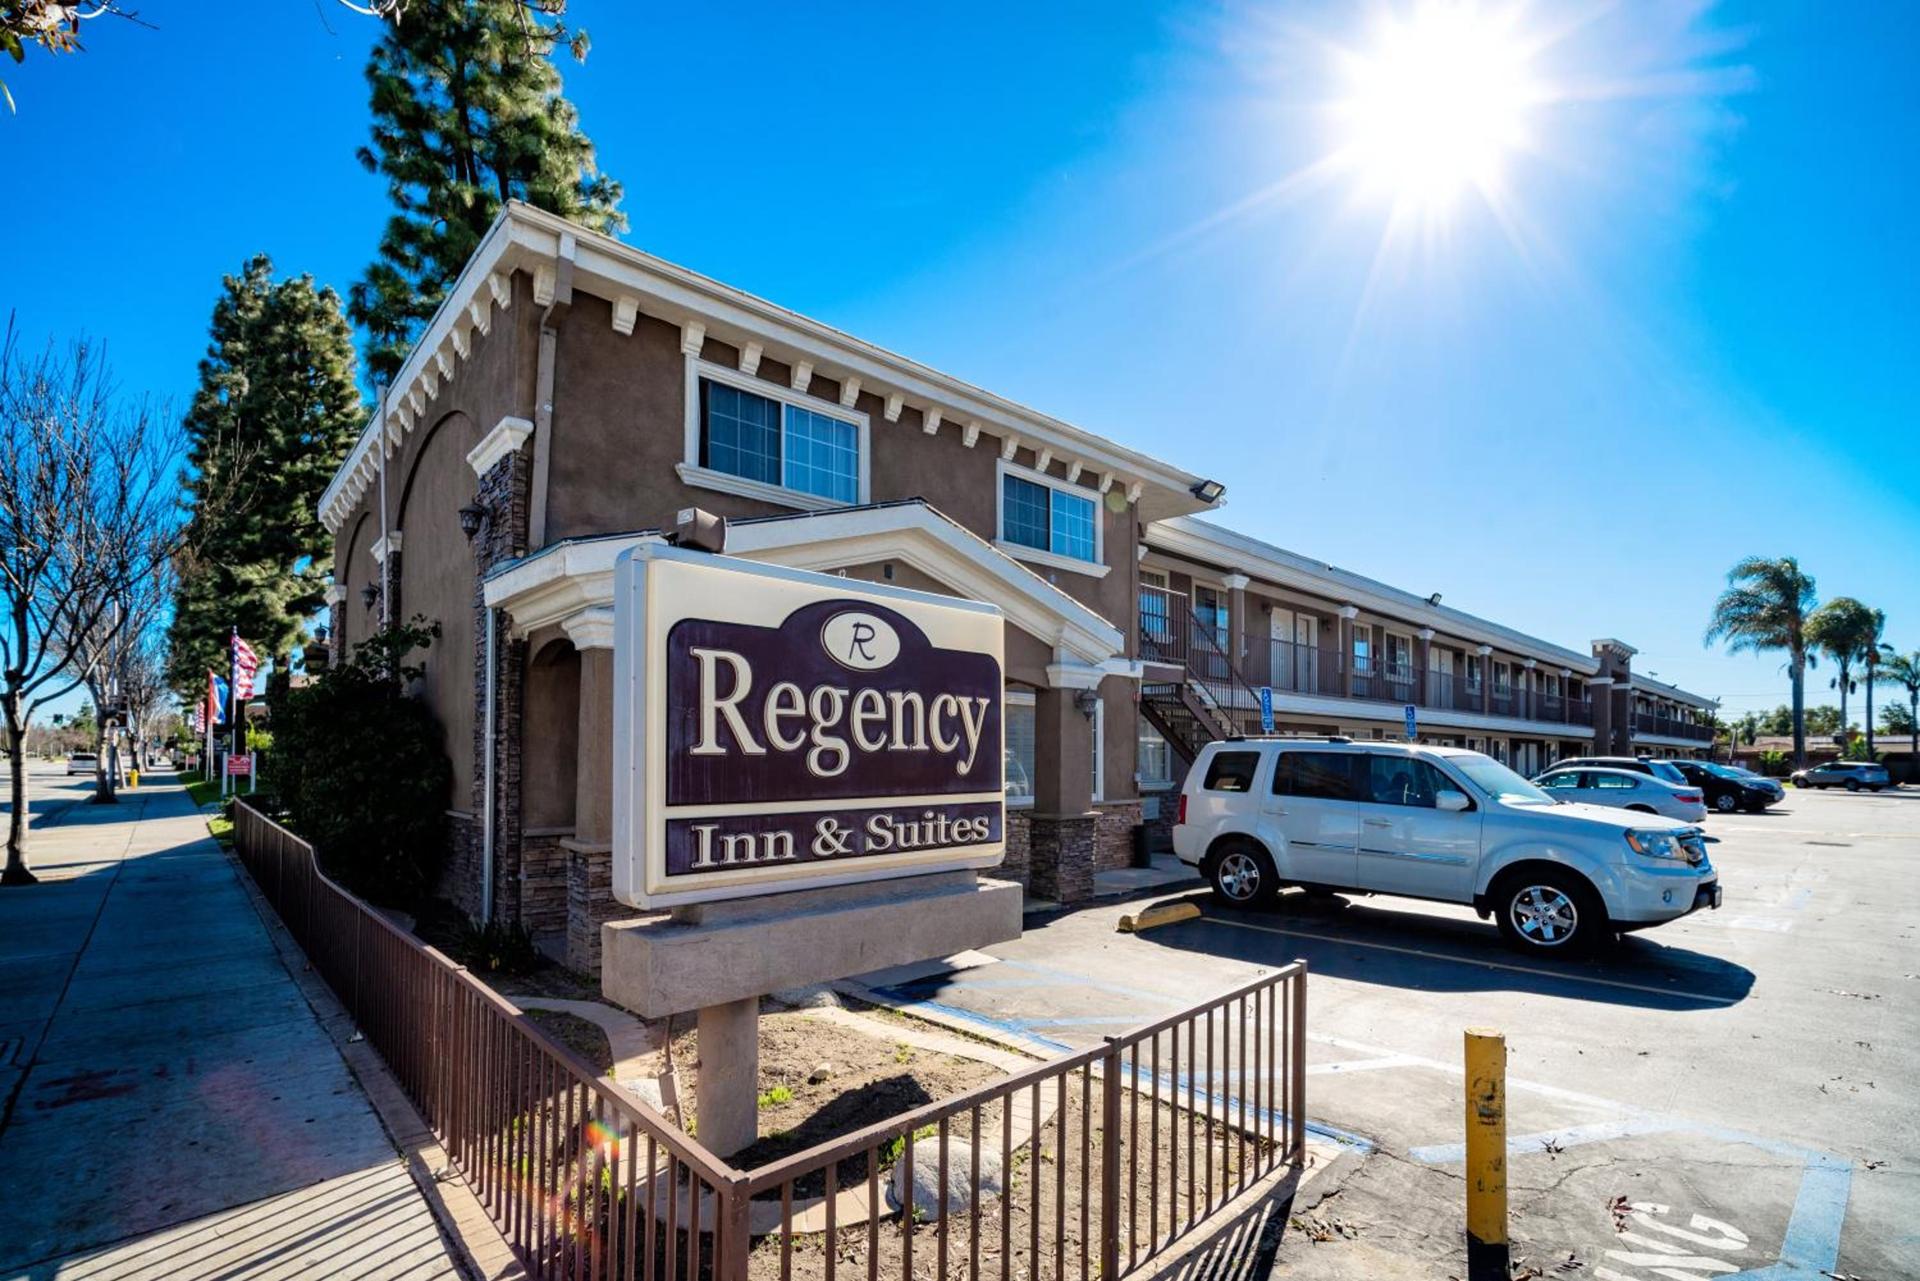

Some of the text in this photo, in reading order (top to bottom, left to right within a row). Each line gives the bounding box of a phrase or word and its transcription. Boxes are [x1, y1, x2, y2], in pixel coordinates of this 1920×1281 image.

[849, 622, 875, 661] R
[690, 647, 989, 776] Regency
[692, 811, 989, 868] Inn & Suites
